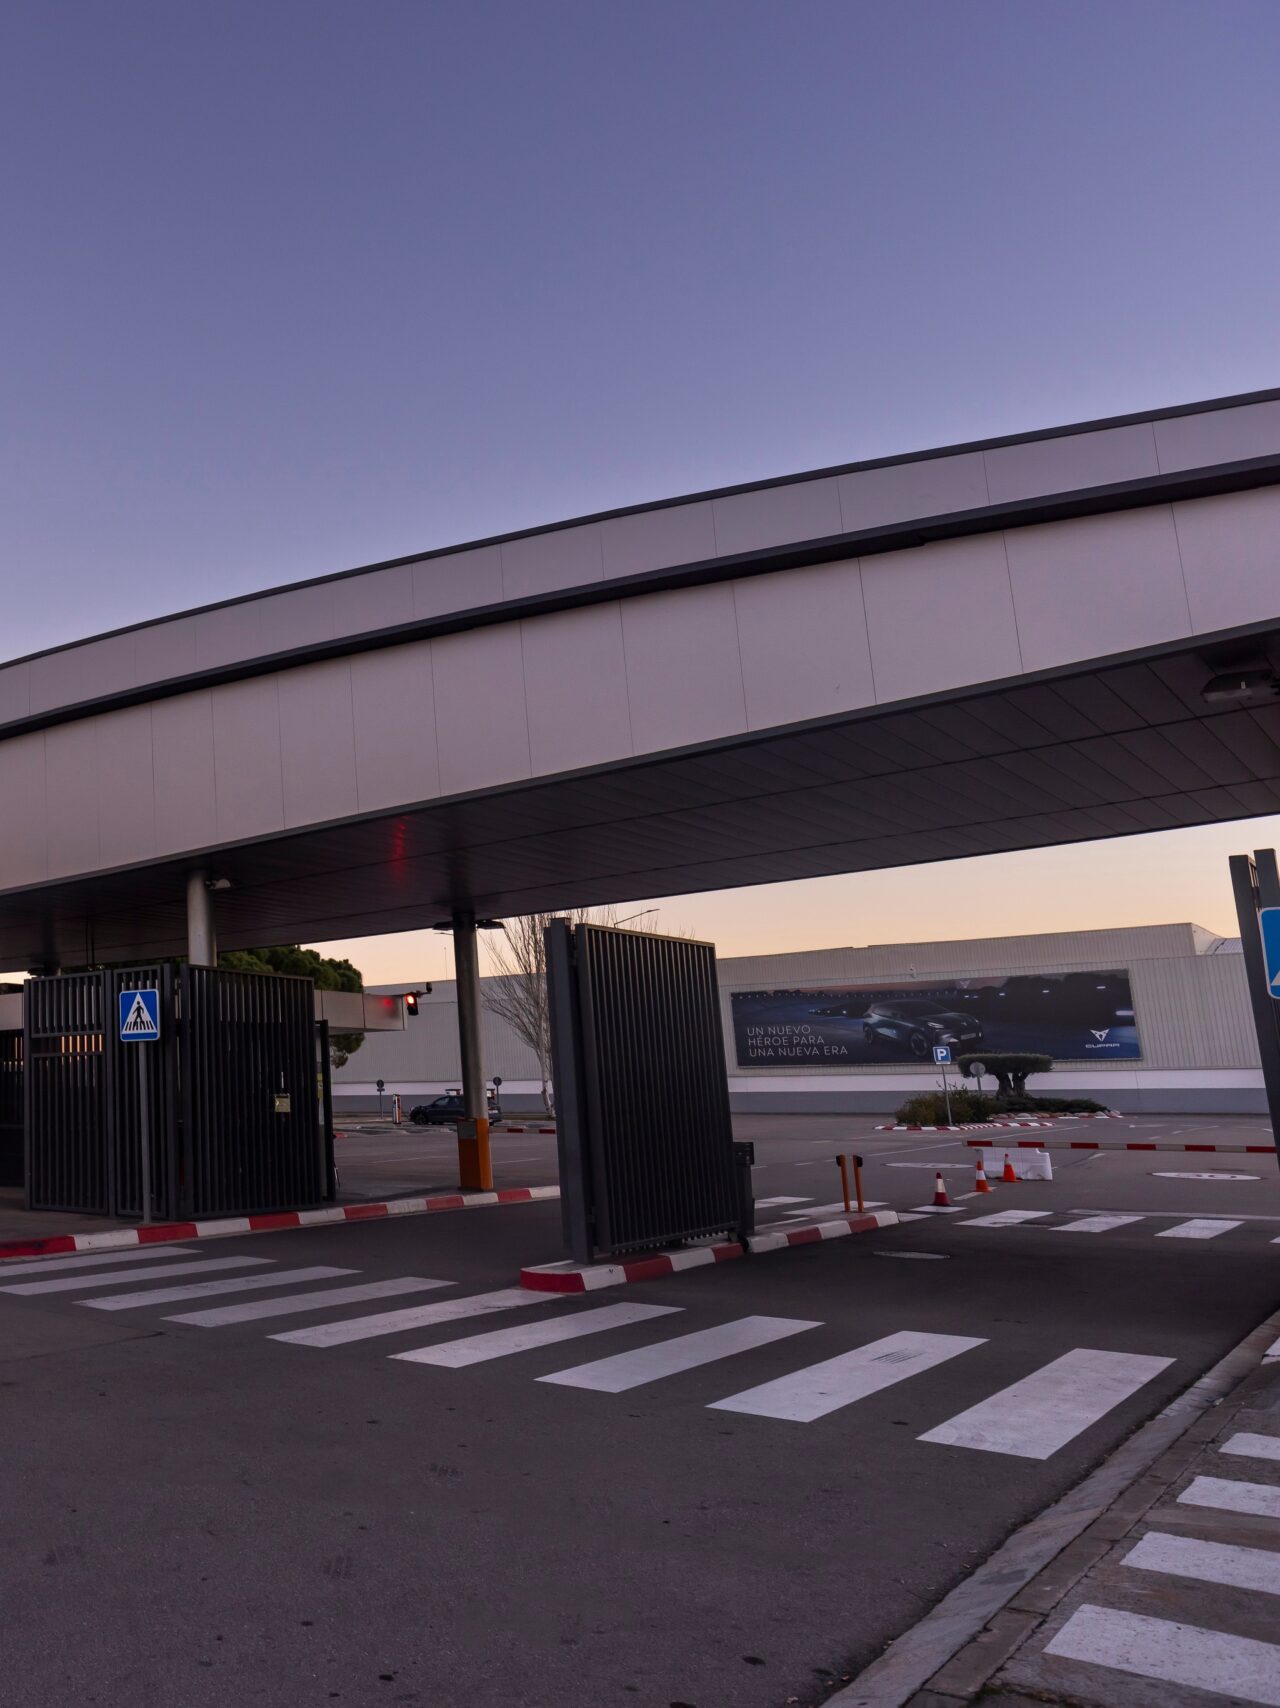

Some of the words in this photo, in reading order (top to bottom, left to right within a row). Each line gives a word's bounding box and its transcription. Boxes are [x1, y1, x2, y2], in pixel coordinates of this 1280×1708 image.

[747, 1027, 764, 1036] UN
[768, 1024, 811, 1035] NUEVO
[748, 1035, 789, 1047] HÉROE
[793, 1035, 825, 1045] PARA
[749, 1047, 775, 1057] UNA
[778, 1046, 820, 1057] NUEVA
[823, 1045, 848, 1056] ERA
[936, 1048, 947, 1061] P
